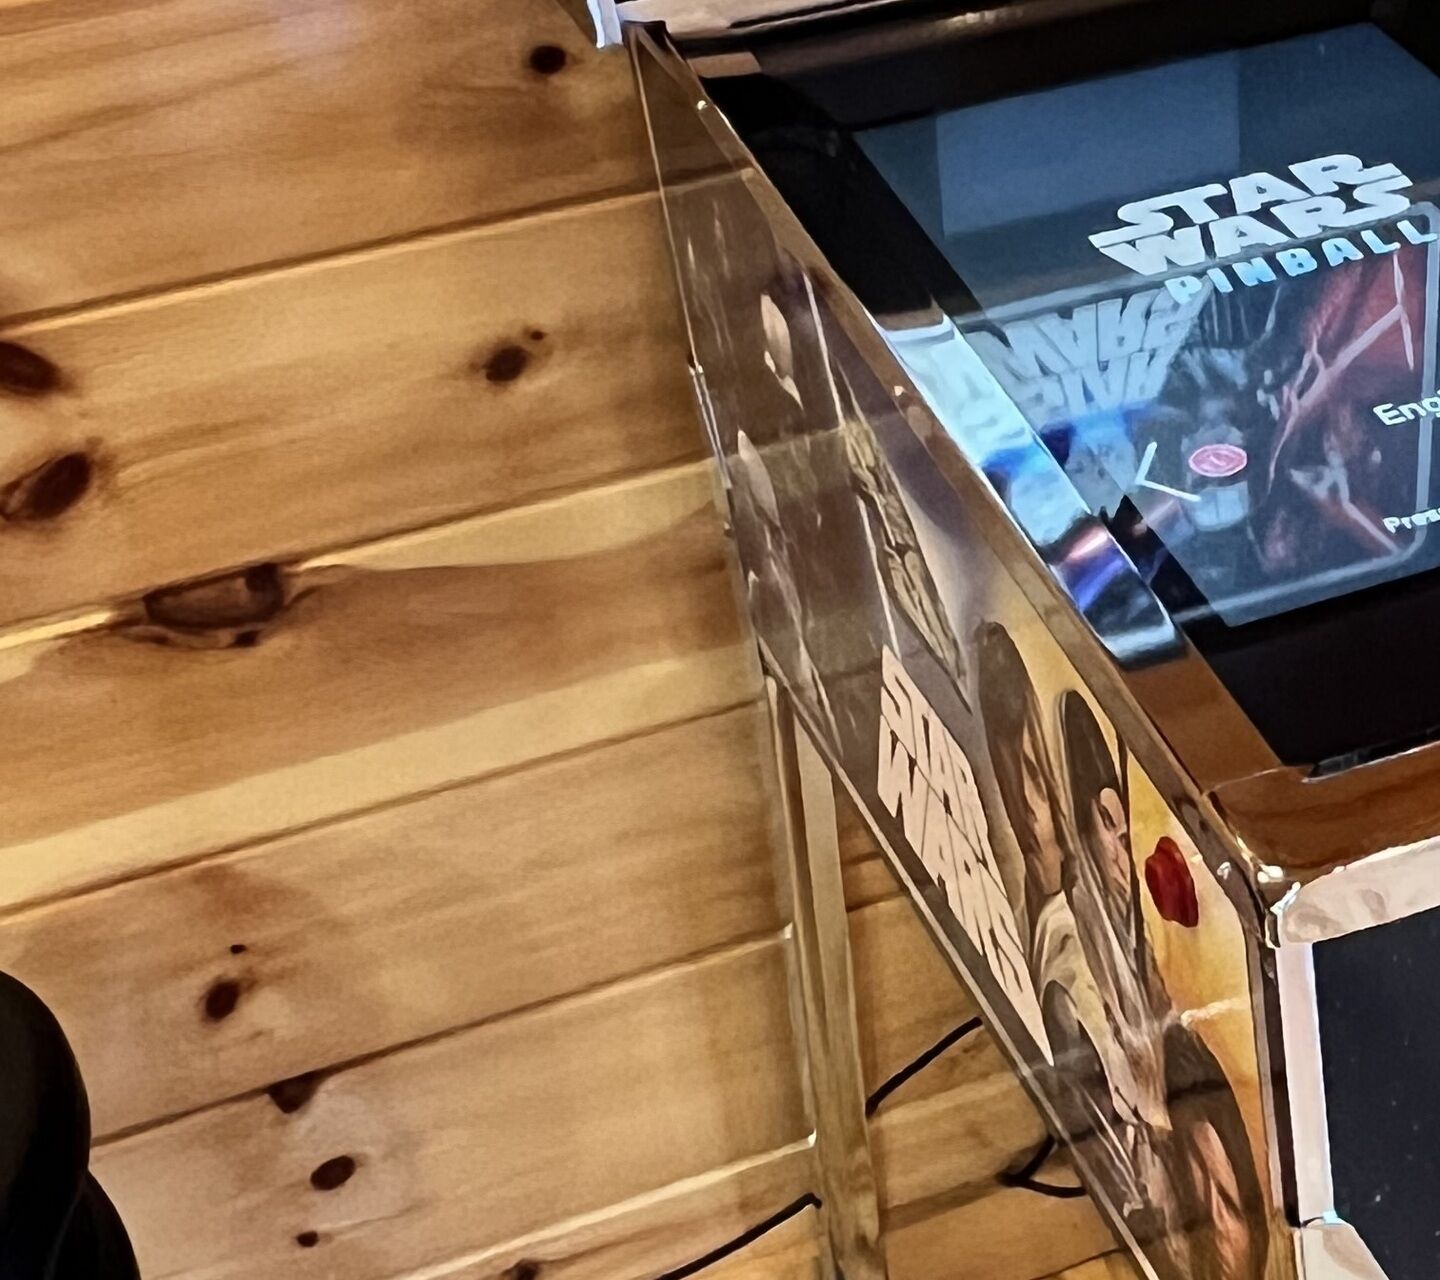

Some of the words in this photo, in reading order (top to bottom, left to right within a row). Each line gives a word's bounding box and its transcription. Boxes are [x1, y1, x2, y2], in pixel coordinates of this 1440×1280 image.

[1088, 154, 1401, 248] STAR
[1099, 174, 1413, 276] WARS
[1164, 219, 1438, 304] PINBALL
[879, 644, 1008, 898] STAR
[877, 715, 1054, 1067] WARS
